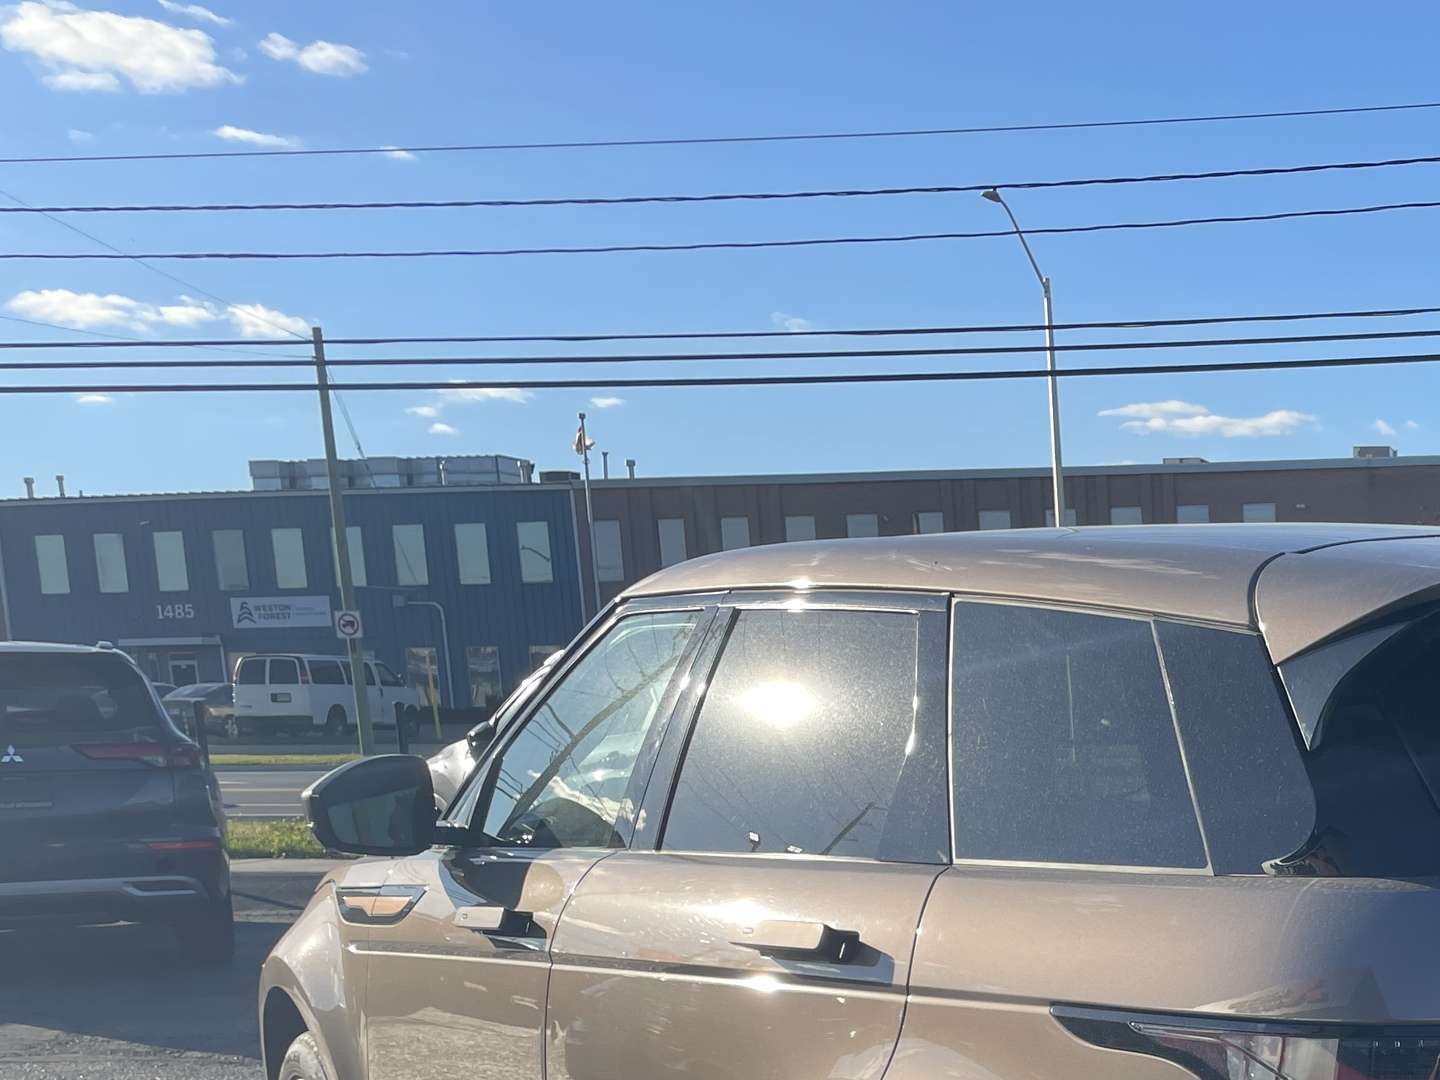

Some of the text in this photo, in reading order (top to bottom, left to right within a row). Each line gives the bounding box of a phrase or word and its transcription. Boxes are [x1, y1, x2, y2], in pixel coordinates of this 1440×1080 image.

[156, 604, 195, 620] 1485
[254, 604, 292, 612] WESTON
[257, 612, 292, 620] FOREST
